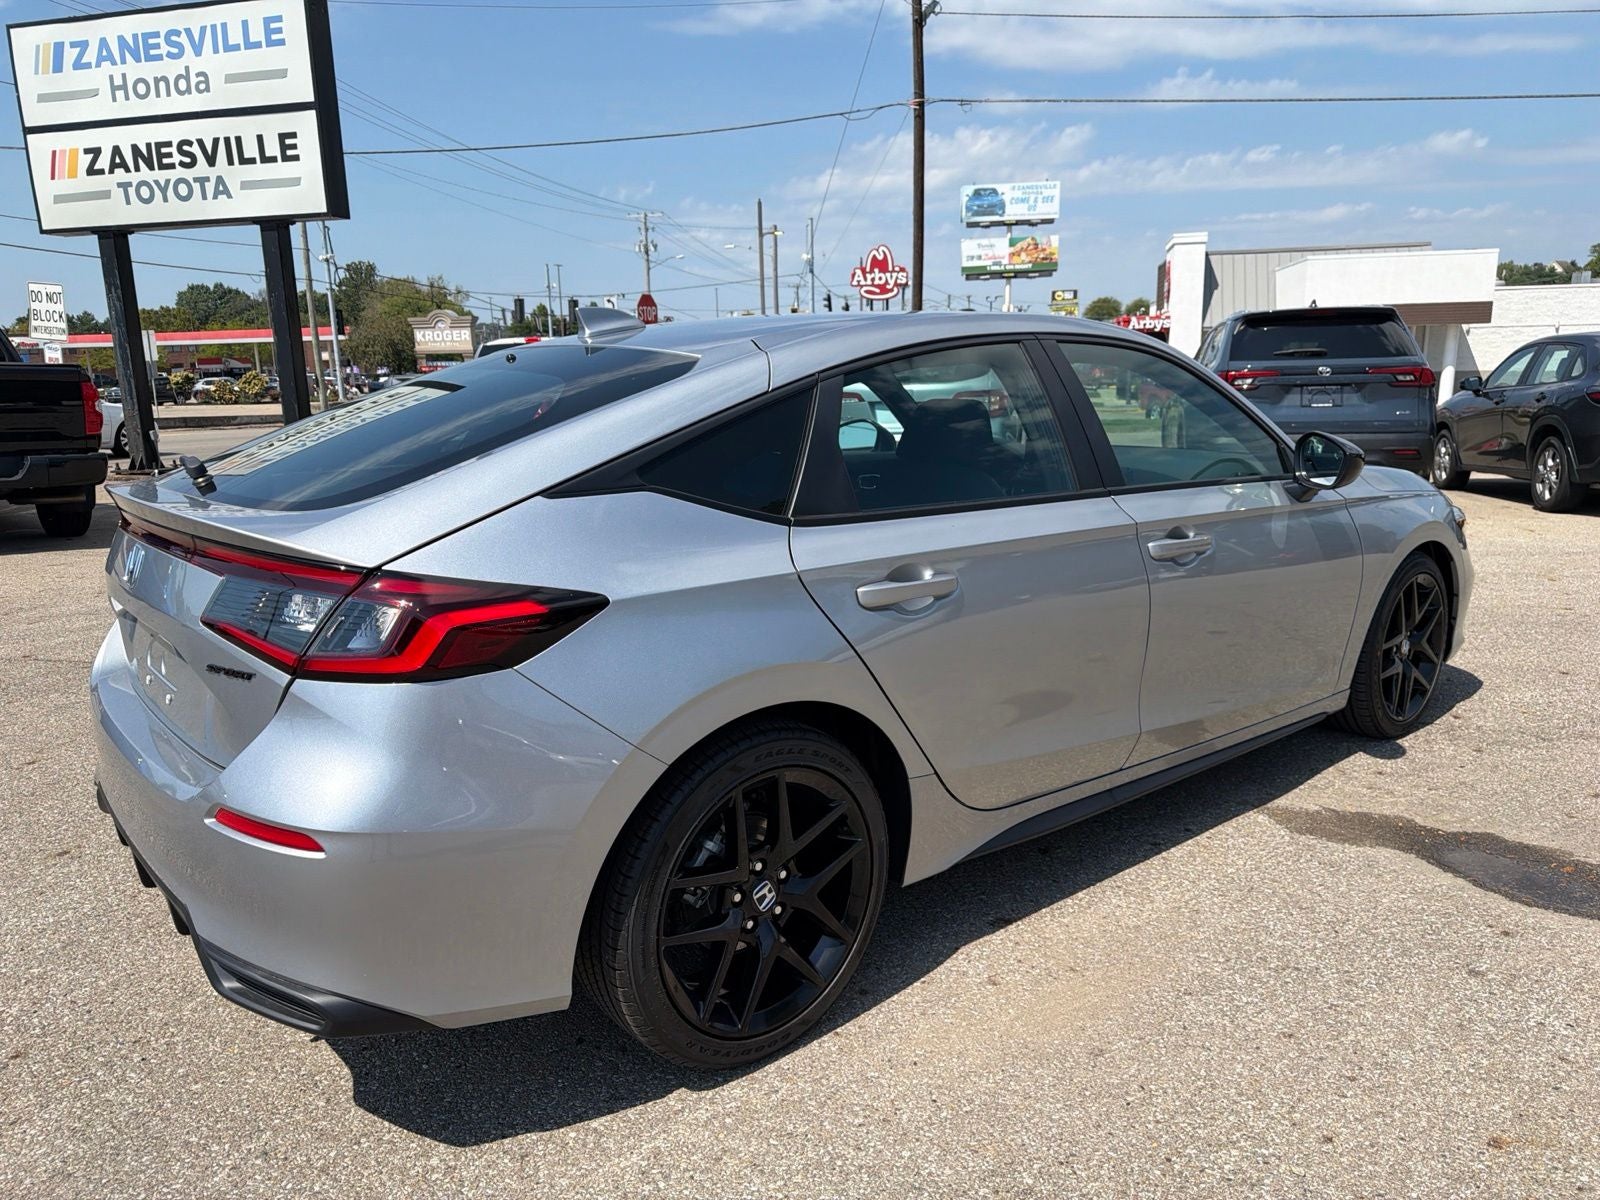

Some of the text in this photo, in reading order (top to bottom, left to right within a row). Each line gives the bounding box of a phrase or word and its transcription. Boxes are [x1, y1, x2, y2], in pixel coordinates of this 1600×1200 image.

[69, 15, 286, 71] ZANESVILLE
[108, 66, 211, 102] Honda
[83, 131, 301, 177] ZANESVILLE
[116, 175, 234, 205] TOYOTA
[851, 268, 907, 289] Arby's
[30, 290, 62, 305] DO NOT
[32, 308, 65, 323] BLOCK
[638, 306, 657, 321] STOP
[31, 325, 66, 336] INTERSECTION
[416, 329, 470, 341] KROGER
